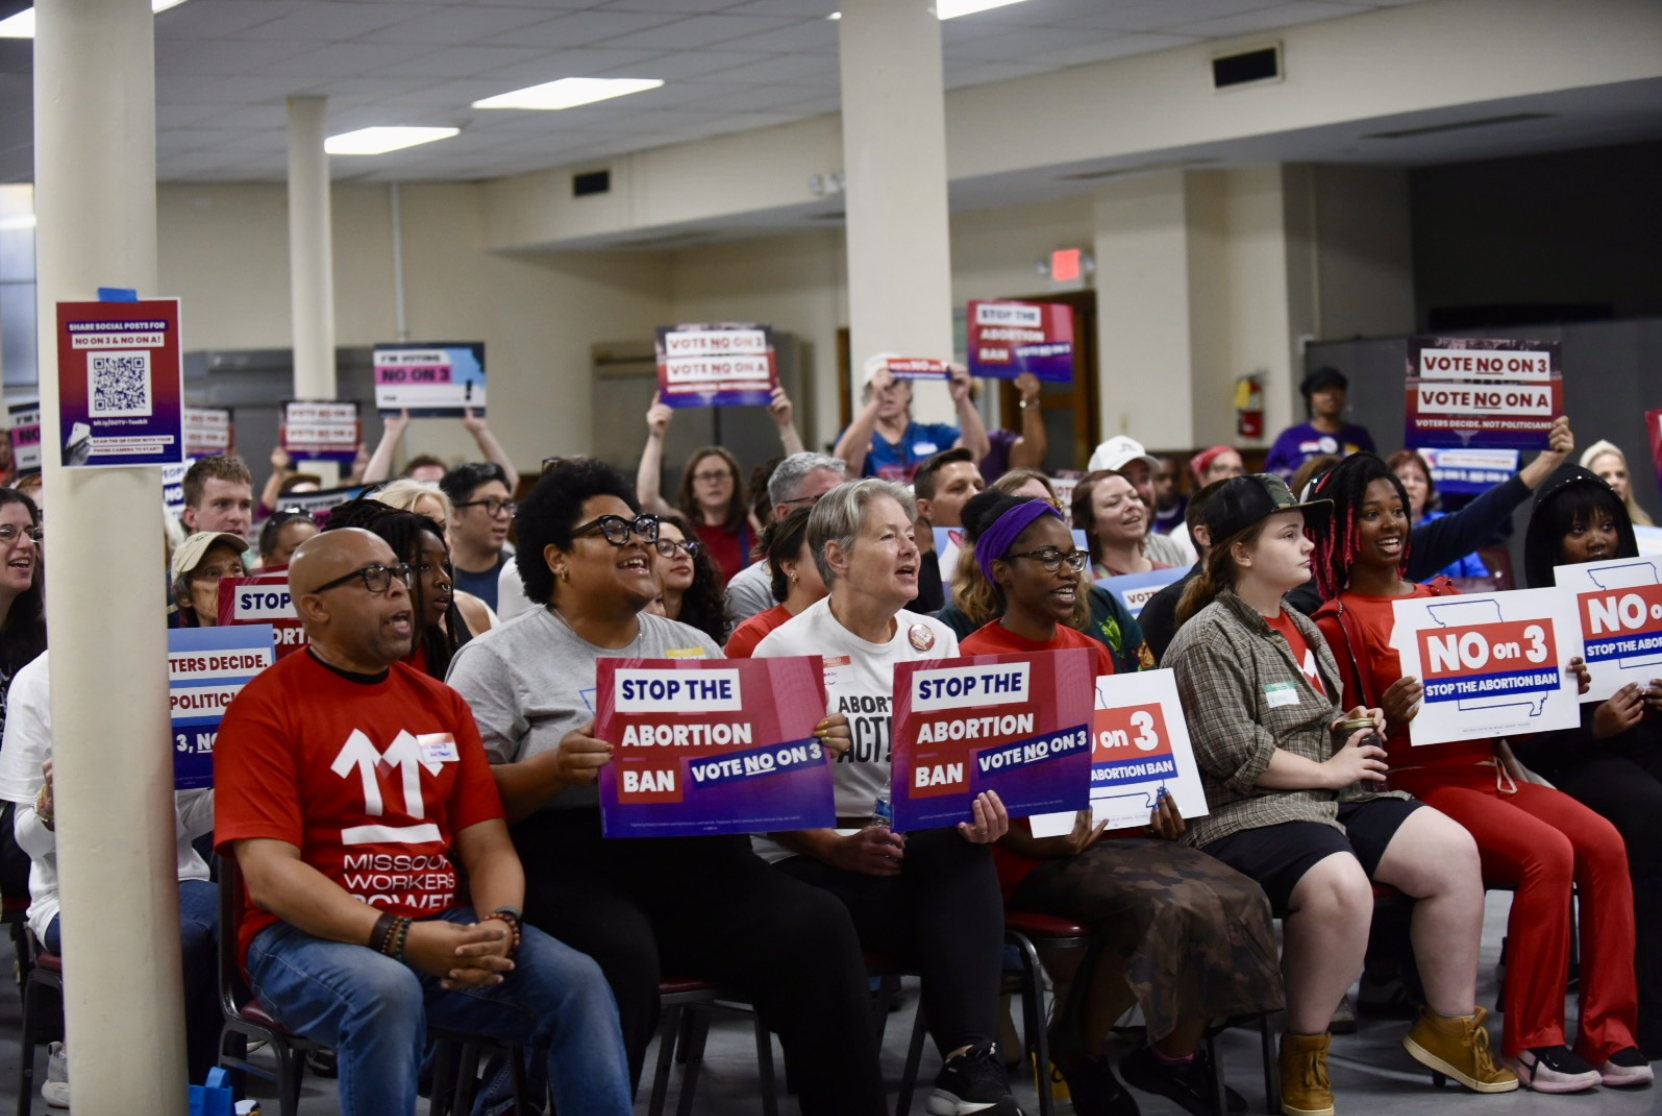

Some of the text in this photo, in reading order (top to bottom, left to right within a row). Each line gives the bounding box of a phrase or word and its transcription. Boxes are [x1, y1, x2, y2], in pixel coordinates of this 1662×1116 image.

[69, 321, 166, 331] SHARE SOCIAL POSTS FOR
[90, 337, 104, 345] ON
[121, 336, 134, 344] NO
[136, 336, 149, 344] ON
[382, 368, 450, 381] NO ON 3
[1424, 357, 1547, 374] VOTE NO ON 3
[1422, 391, 1549, 409] VOTE NO ON A
[1416, 419, 1448, 428] VOTERS
[1449, 420, 1482, 428] DECIDE.
[1483, 420, 1500, 428] NOT
[241, 593, 292, 610] STOP
[1127, 592, 1159, 604] VOT
[1587, 593, 1662, 634] NO o
[1427, 624, 1548, 673] NO on 3
[1587, 643, 1616, 657] STOP
[1616, 640, 1637, 653] THE
[209, 655, 268, 671] DECIDE.
[622, 679, 732, 700] STOP THE
[919, 672, 1022, 700] STOP THE
[1426, 673, 1557, 697] STOP THE ABORTION BAN
[621, 722, 752, 747] ABORTION
[916, 713, 1034, 744] ABORTION
[1099, 729, 1129, 748] on
[1130, 710, 1159, 751] 3
[176, 734, 194, 753] 3,
[978, 748, 1022, 772] VOTE
[1024, 741, 1049, 764] NO
[1050, 733, 1075, 752] ON
[1077, 730, 1087, 746] 3
[692, 743, 822, 782] VOTE NO ON 3
[1091, 760, 1174, 781] ABORTION BAN
[622, 770, 675, 793] BAN
[915, 763, 963, 788] BAN
[343, 872, 455, 890] WORKERS
